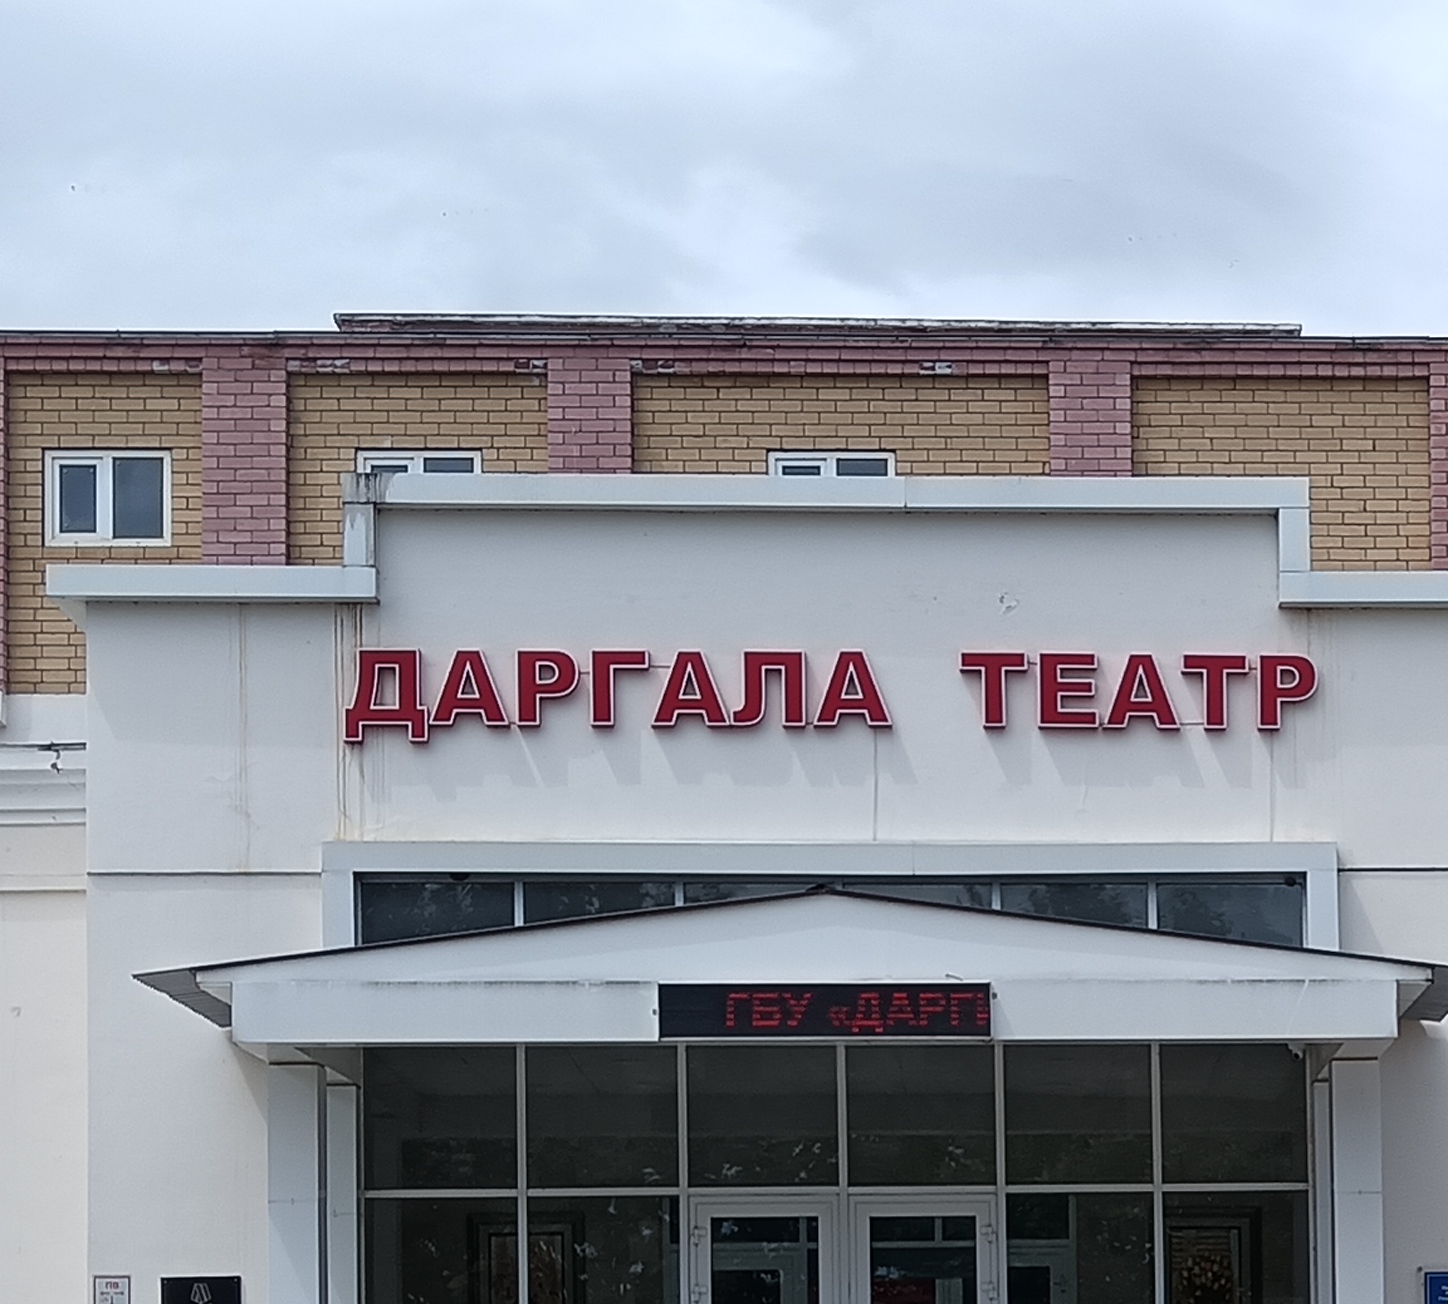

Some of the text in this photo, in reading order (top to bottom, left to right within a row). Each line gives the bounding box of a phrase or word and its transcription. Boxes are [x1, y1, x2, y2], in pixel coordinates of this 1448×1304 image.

[345, 648, 1319, 743] ДАРГАЛА ТЕАТР
[725, 992, 812, 1028] ГБУ
